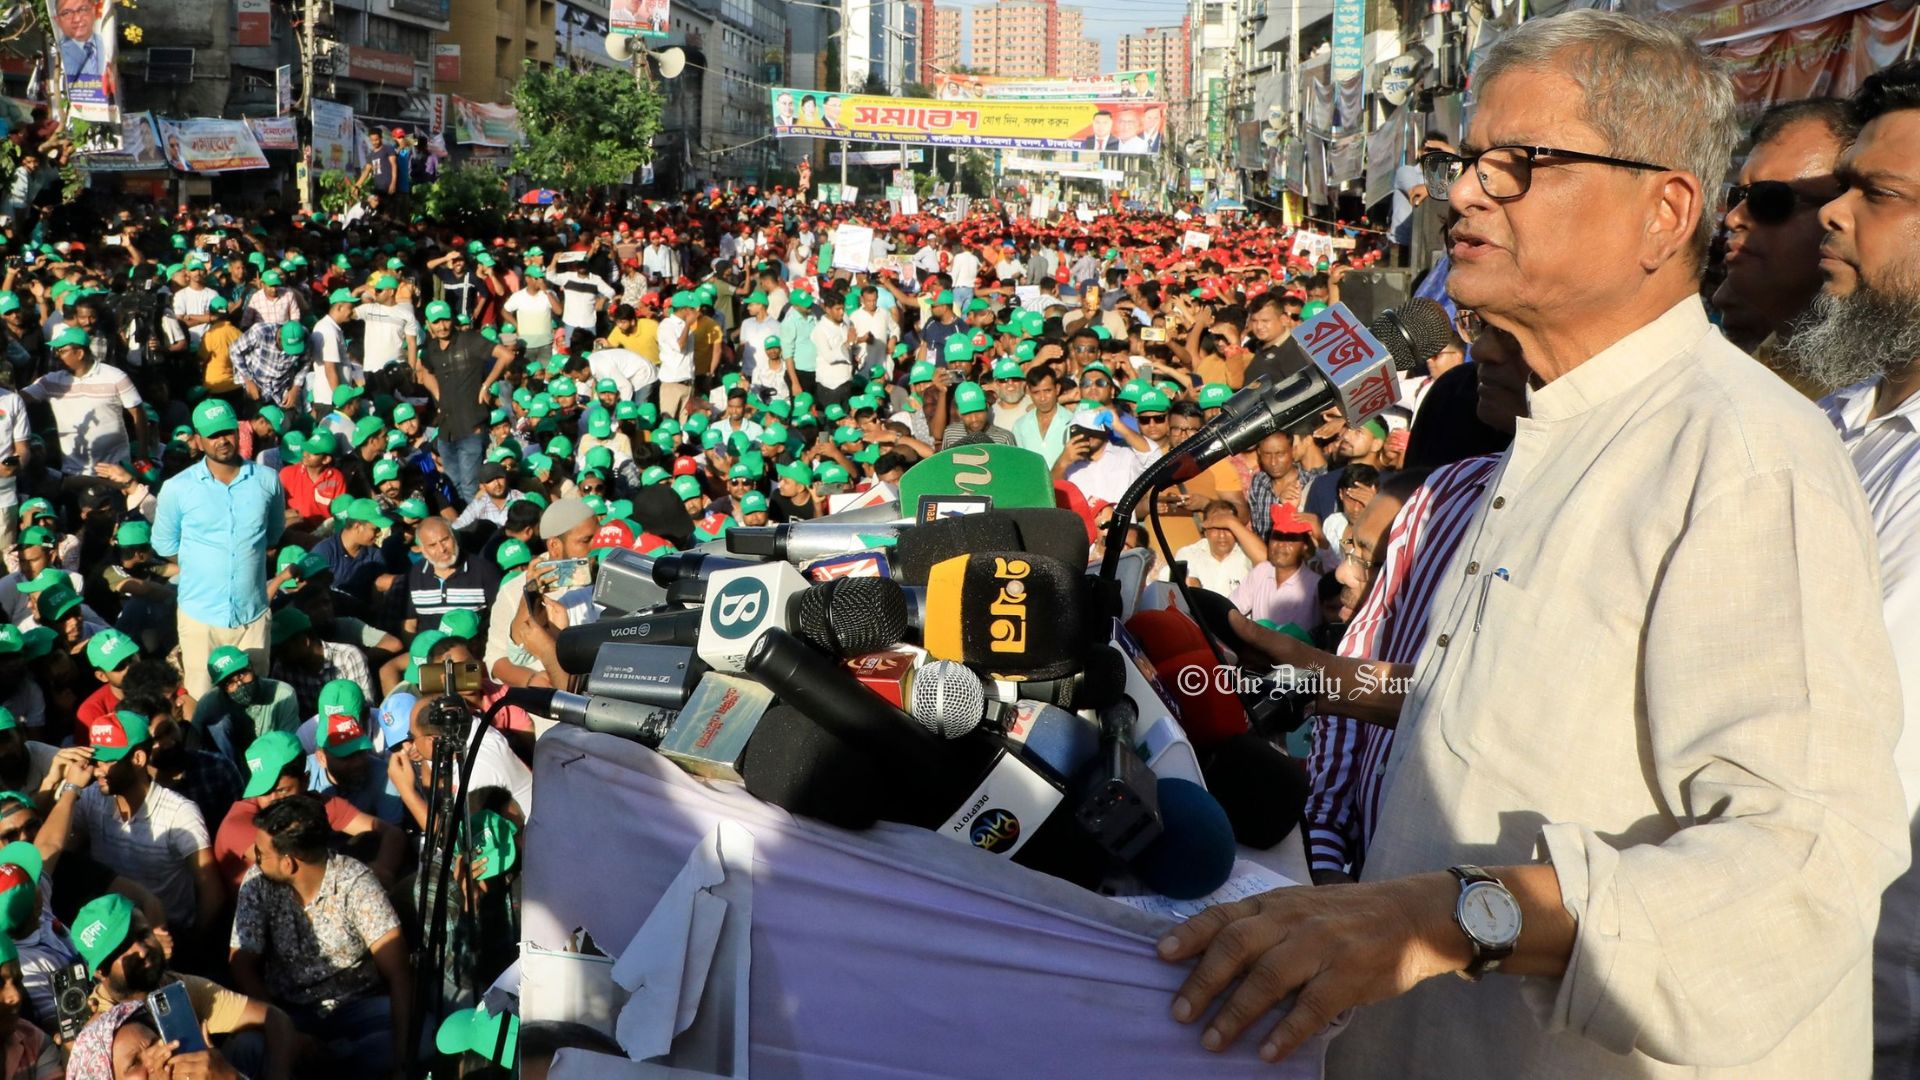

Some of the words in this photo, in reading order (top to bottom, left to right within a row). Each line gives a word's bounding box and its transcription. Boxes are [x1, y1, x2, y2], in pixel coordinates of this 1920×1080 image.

[854, 106, 979, 132] সমাবেশ
[983, 114, 1001, 127] যোগ
[1003, 114, 1020, 128] দিন,
[1024, 115, 1045, 127] সফল
[1048, 117, 1069, 128] করুন
[973, 135, 1012, 146] উপজেলা
[1303, 311, 1375, 376] রাজ
[1348, 365, 1396, 426] রাজ
[991, 557, 1031, 654] এখন
[611, 626, 637, 637] BOYA
[602, 672, 658, 682] SENNHEISER
[962, 794, 989, 824] DEEPTO
[953, 822, 964, 833] TV
